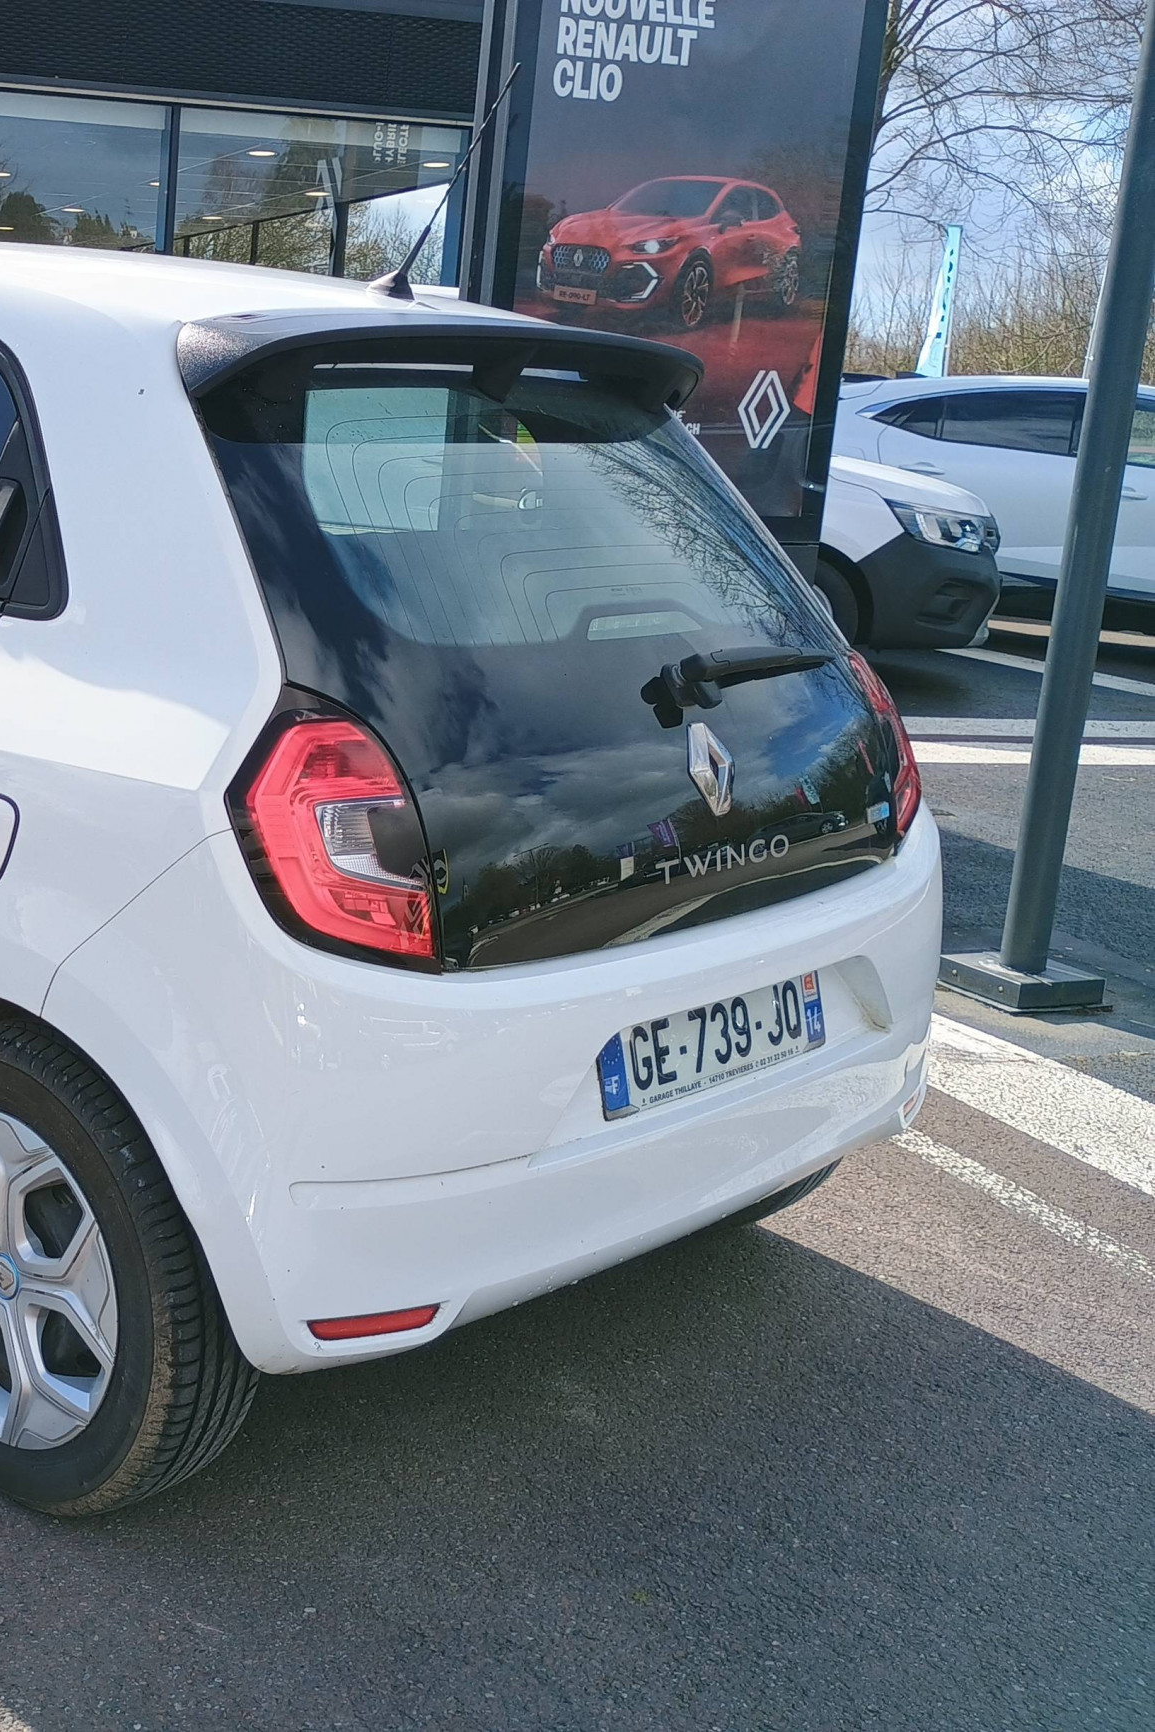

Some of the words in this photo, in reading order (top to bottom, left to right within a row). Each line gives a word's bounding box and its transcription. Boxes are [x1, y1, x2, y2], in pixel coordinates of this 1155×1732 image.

[557, 16, 698, 66] RENAULT
[553, 58, 623, 102] CLIO
[655, 834, 789, 885] TWINGO
[649, 1090, 674, 1104] GARAGE
[675, 1080, 702, 1096] THILLAYE
[708, 1072, 725, 1084] 14710
